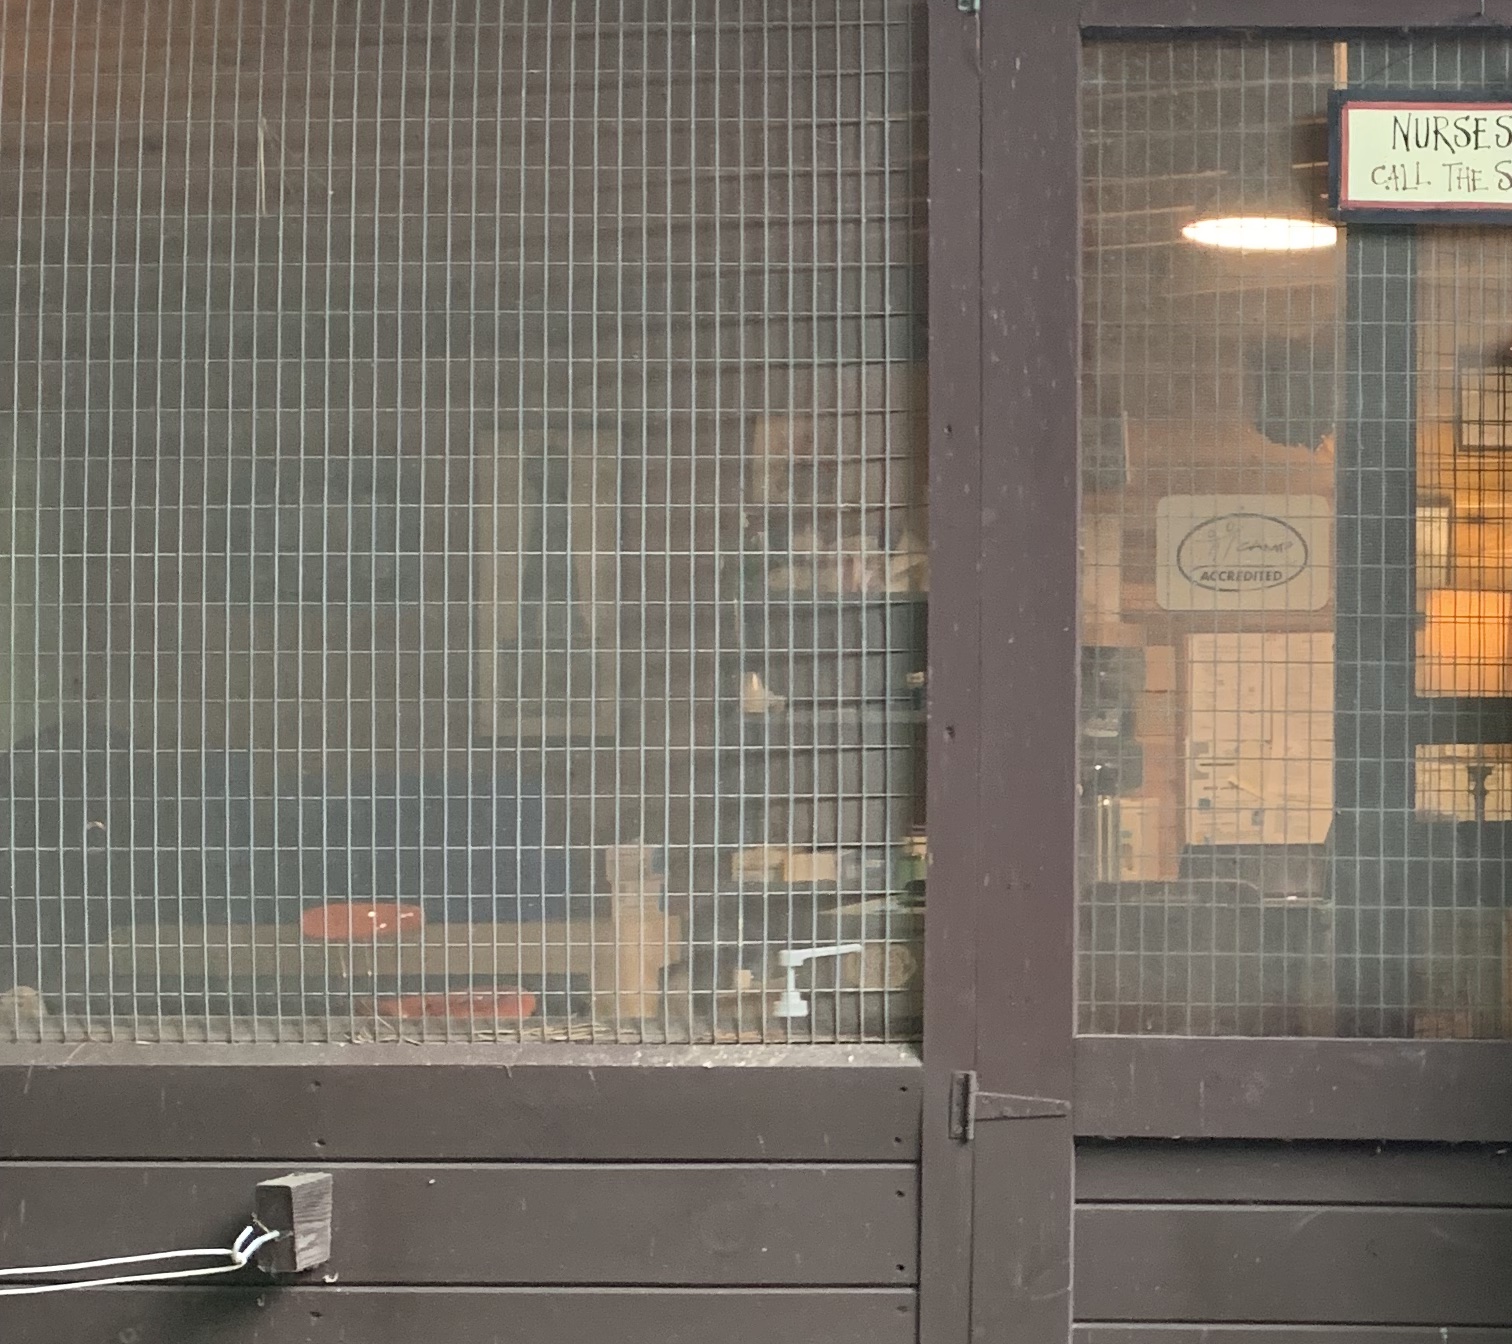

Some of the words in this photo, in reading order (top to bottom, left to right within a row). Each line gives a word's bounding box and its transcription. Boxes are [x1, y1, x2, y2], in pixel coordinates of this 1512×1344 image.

[1371, 161, 1431, 191] CALL
[1442, 161, 1489, 193] THE
[1200, 570, 1284, 582] ACCREDITED
